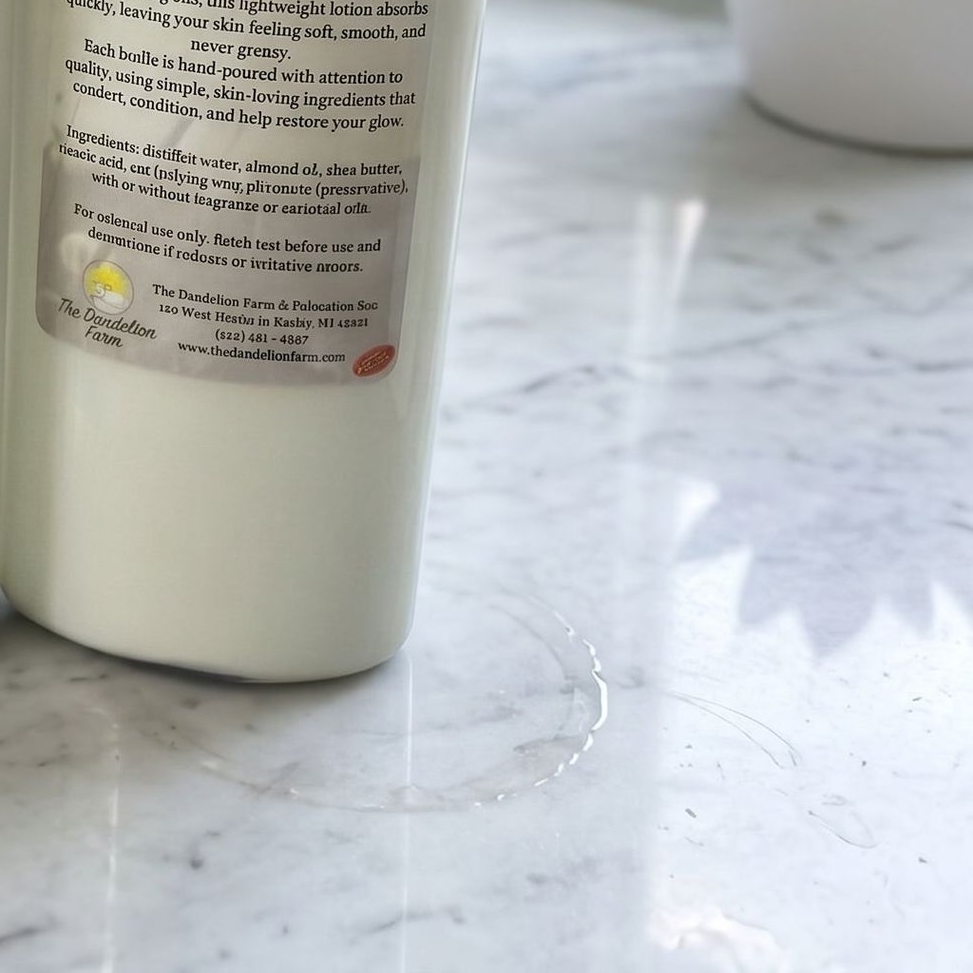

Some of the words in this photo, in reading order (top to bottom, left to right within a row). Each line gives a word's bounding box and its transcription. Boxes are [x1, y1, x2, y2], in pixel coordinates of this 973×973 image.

[120, 1, 170, 28] leaving
[173, 16, 209, 29] your
[213, 17, 244, 33] skin
[249, 20, 302, 40] feeling
[305, 25, 337, 40] soft,
[341, 25, 399, 40] smooth,
[402, 24, 425, 38] and
[330, 1, 372, 16] lotion
[377, 1, 428, 15] absorbs
[84, 39, 115, 58] Each
[163, 55, 174, 69] is
[179, 57, 277, 81] hand-poured
[281, 69, 314, 84] with
[319, 71, 385, 84] attention
[389, 73, 403, 83] to
[191, 39, 234, 54] never
[66, 59, 112, 82] quality,
[116, 71, 153, 91] using
[157, 78, 209, 100] simple,
[214, 85, 299, 109] skin-loving
[304, 92, 386, 110] ingredients
[389, 92, 415, 105] that
[73, 82, 126, 105] condert,
[130, 95, 203, 119] condition,
[207, 108, 234, 122] and
[239, 110, 272, 128] help
[276, 115, 329, 128] restore
[332, 119, 366, 132] your
[369, 114, 404, 132] glow.
[67, 125, 140, 155] Ingredients:
[200, 157, 242, 173] water,
[245, 160, 299, 175] almond
[326, 163, 357, 175] shea
[361, 164, 402, 175] butter,
[99, 156, 126, 173] acid,
[92, 172, 118, 188] with
[122, 181, 135, 191] or
[138, 184, 190, 203] without
[263, 204, 278, 213] or
[74, 203, 94, 220] For
[151, 225, 173, 238] use
[177, 230, 209, 246] only.
[256, 238, 281, 251] test
[285, 239, 327, 253] before
[331, 242, 354, 252] use
[357, 239, 381, 252] and
[164, 244, 174, 257] if
[232, 257, 247, 267] or
[152, 283, 175, 297] The
[178, 289, 239, 307] Dandelion
[243, 298, 275, 310] Farm
[278, 300, 289, 310] &
[58, 298, 81, 319] The
[84, 307, 157, 339] Dandelion
[182, 306, 211, 321] West
[258, 316, 270, 327] in
[85, 326, 123, 348] Farm
[178, 342, 345, 363] www.thedandelionfarm.com
